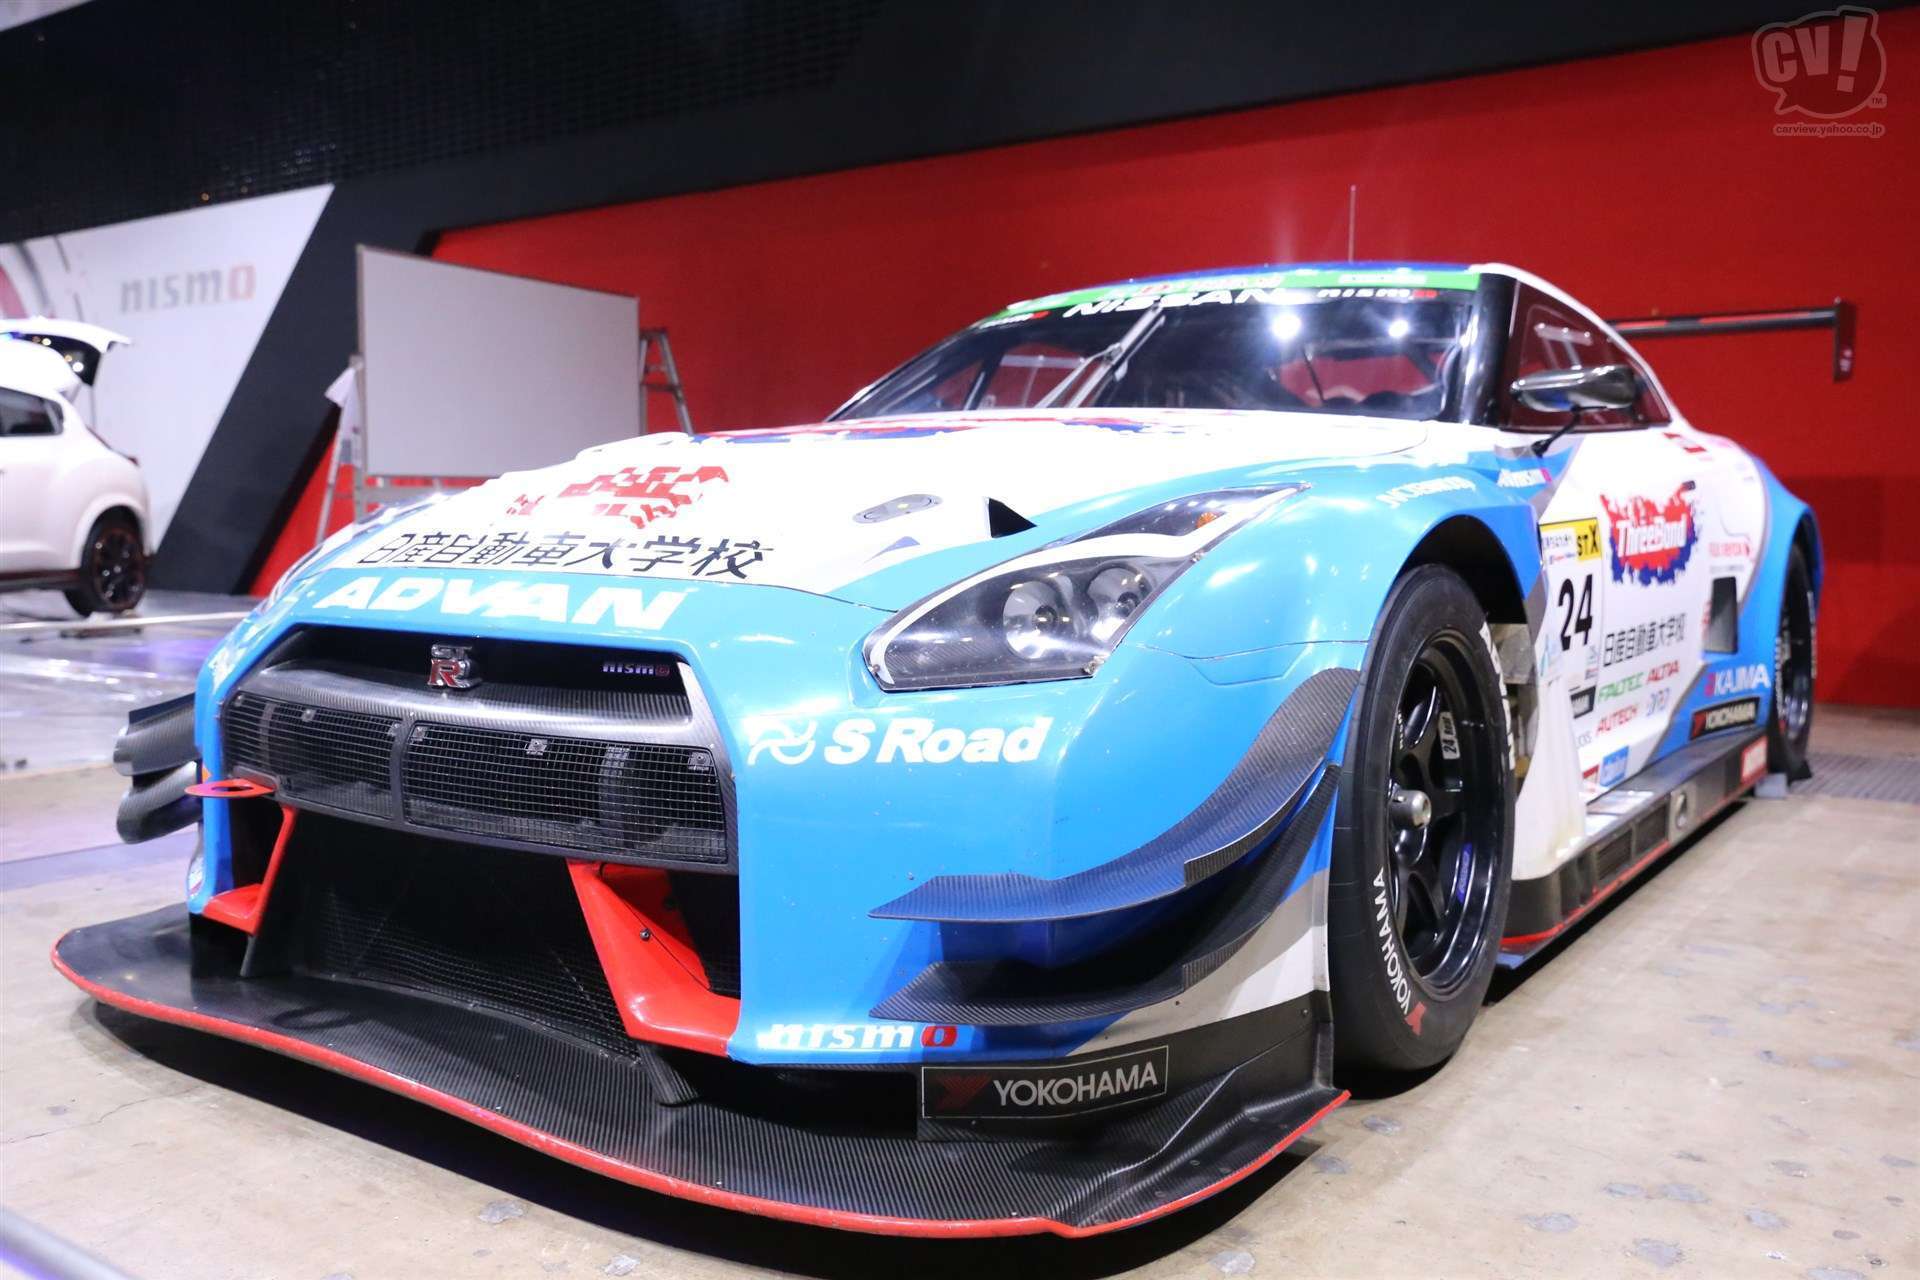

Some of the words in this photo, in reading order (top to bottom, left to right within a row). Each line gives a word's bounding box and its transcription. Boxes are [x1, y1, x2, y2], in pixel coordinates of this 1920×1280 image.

[1063, 287, 1292, 317] NISSAN
[357, 531, 775, 580] 日産自動車大学校
[1615, 513, 1688, 558] ThreeBond
[313, 576, 692, 631] ADVAN
[1558, 574, 1593, 651] 24
[824, 718, 876, 765] S
[876, 717, 1054, 764] Road
[1442, 738, 1457, 754] 24
[1373, 866, 1411, 1015] YOKOHAMA
[993, 1061, 1158, 1106] YOKOHAMA
